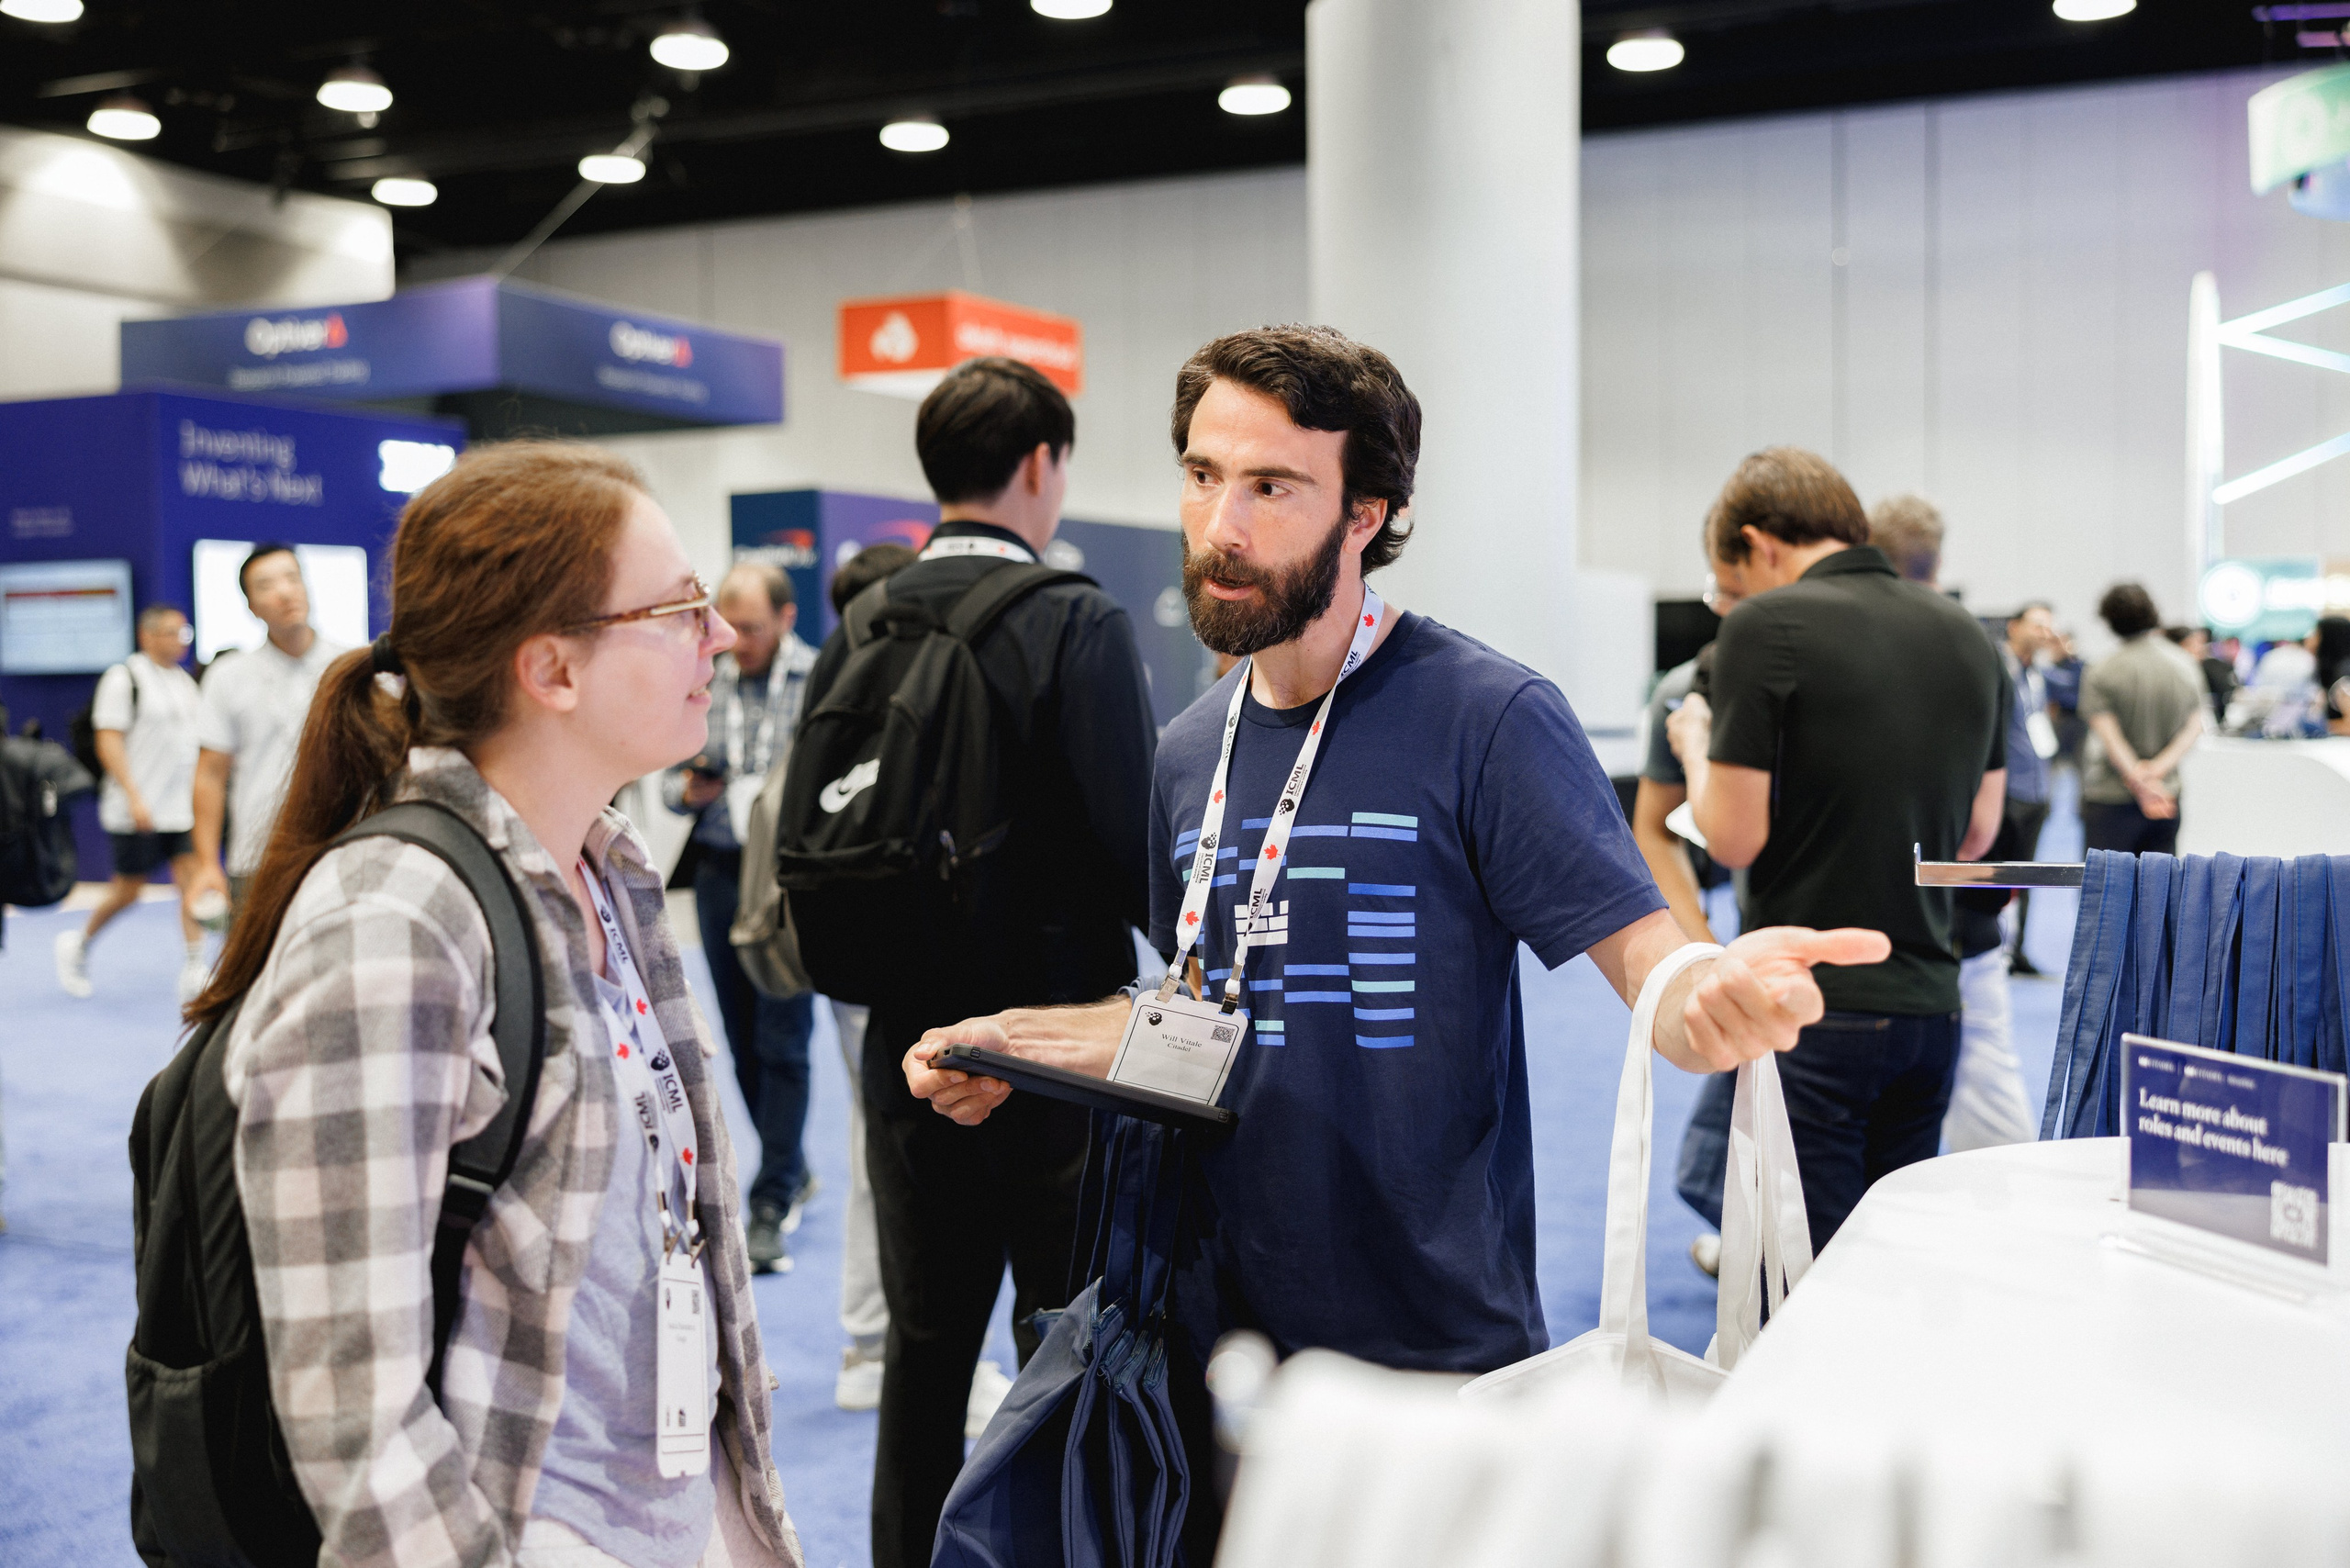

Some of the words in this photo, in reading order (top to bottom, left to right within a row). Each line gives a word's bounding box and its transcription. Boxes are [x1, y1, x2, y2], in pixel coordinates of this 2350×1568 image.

[1285, 764, 1304, 795] ICML
[1198, 853, 1214, 883] ICML
[1161, 1033, 1178, 1042] Will
[1181, 1037, 1203, 1047] Vitale
[1167, 1042, 1192, 1052] Citadel
[634, 1090, 653, 1129] ICML
[663, 1072, 684, 1113] ICML
[2139, 1086, 2181, 1116] Learn
[2182, 1101, 2222, 1126] more
[2221, 1103, 2268, 1137] about
[2138, 1113, 2174, 1139] roles
[2173, 1122, 2202, 1147] and
[2203, 1130, 2253, 1159] events
[2252, 1134, 2290, 1169] here
